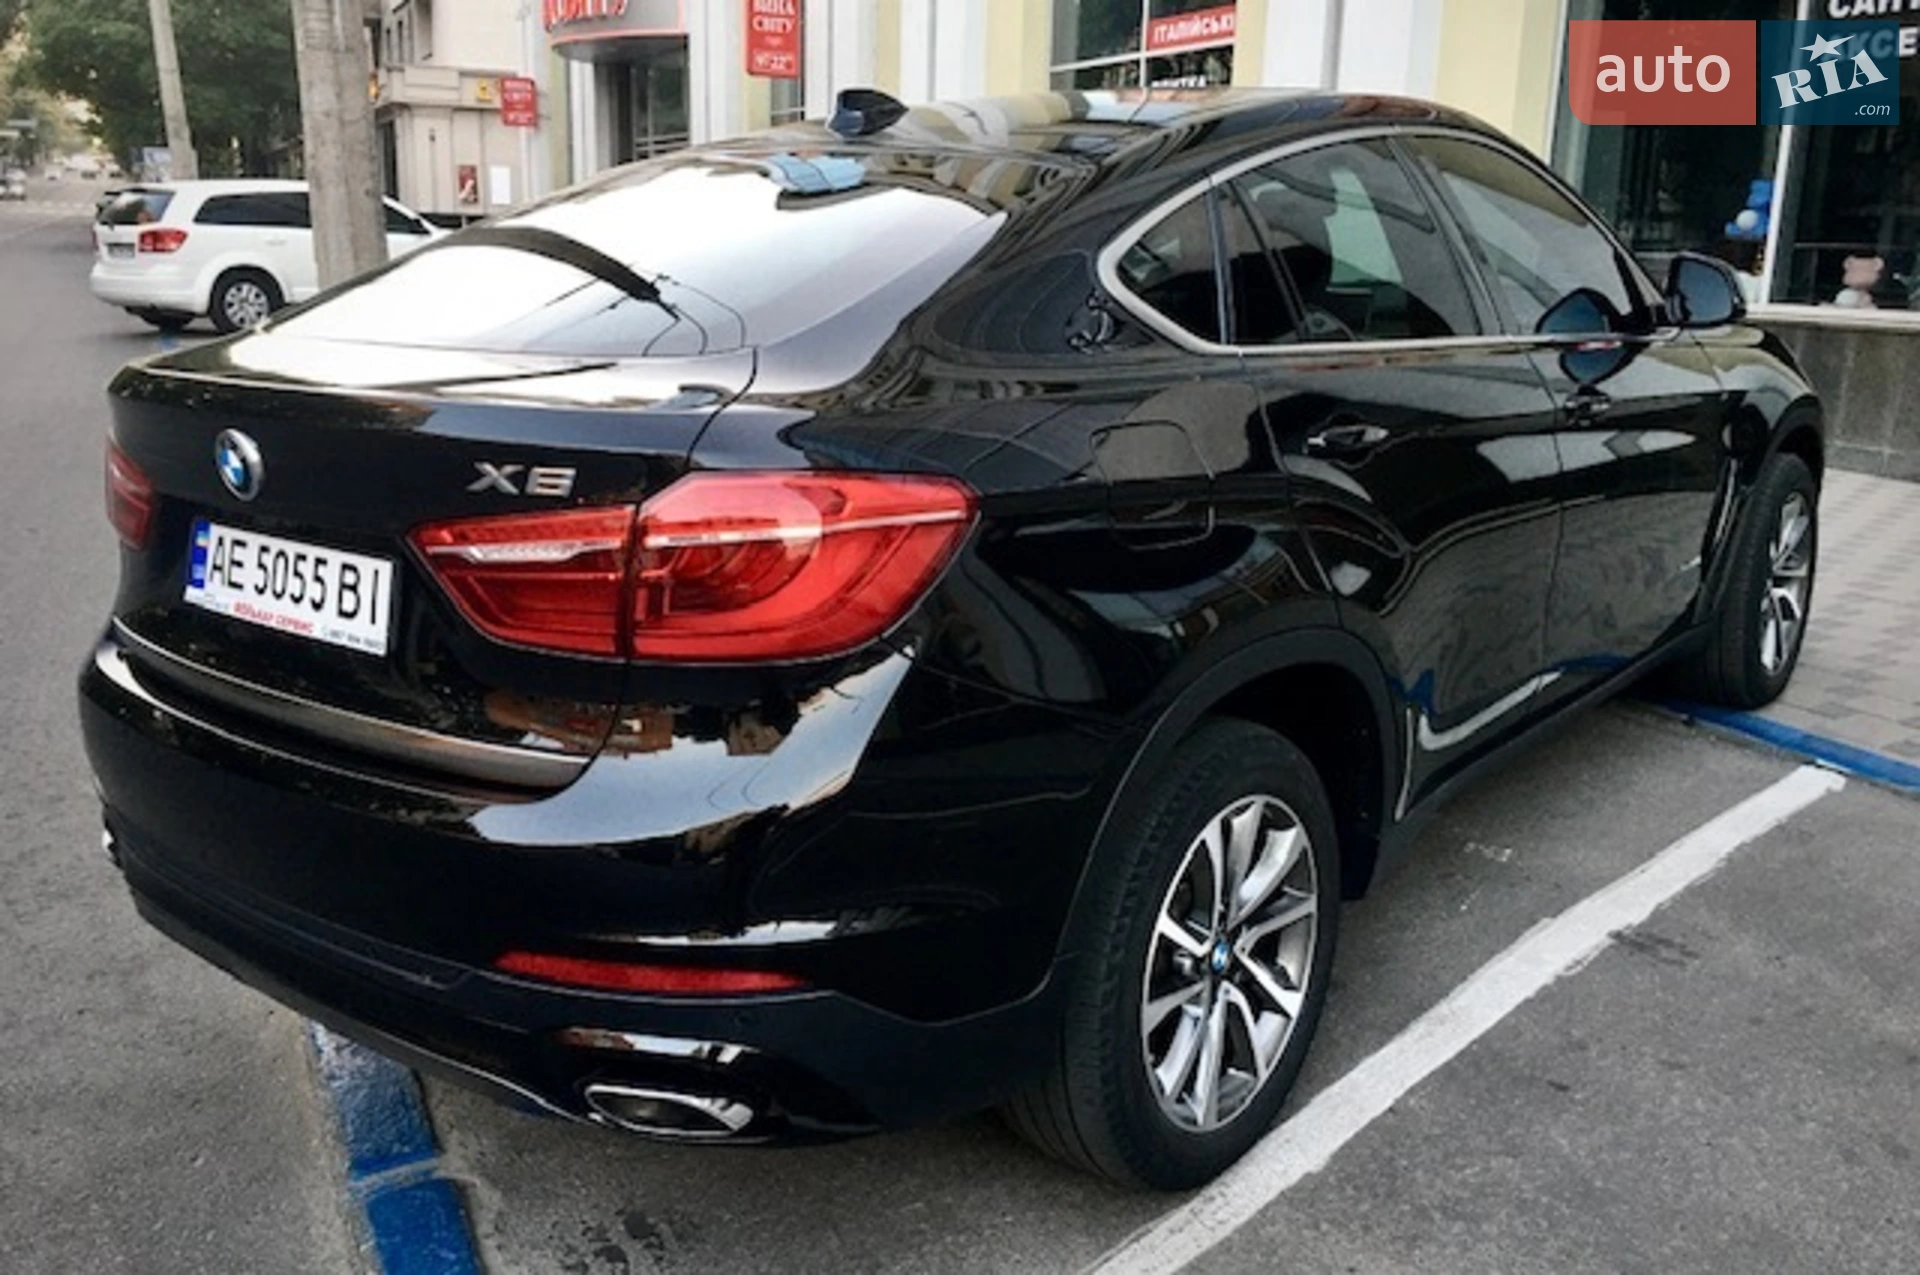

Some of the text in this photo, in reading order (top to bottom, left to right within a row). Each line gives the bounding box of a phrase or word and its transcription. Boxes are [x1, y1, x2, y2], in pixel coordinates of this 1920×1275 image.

[466, 461, 577, 497] X6
[210, 536, 379, 625] AE 5055 BI
